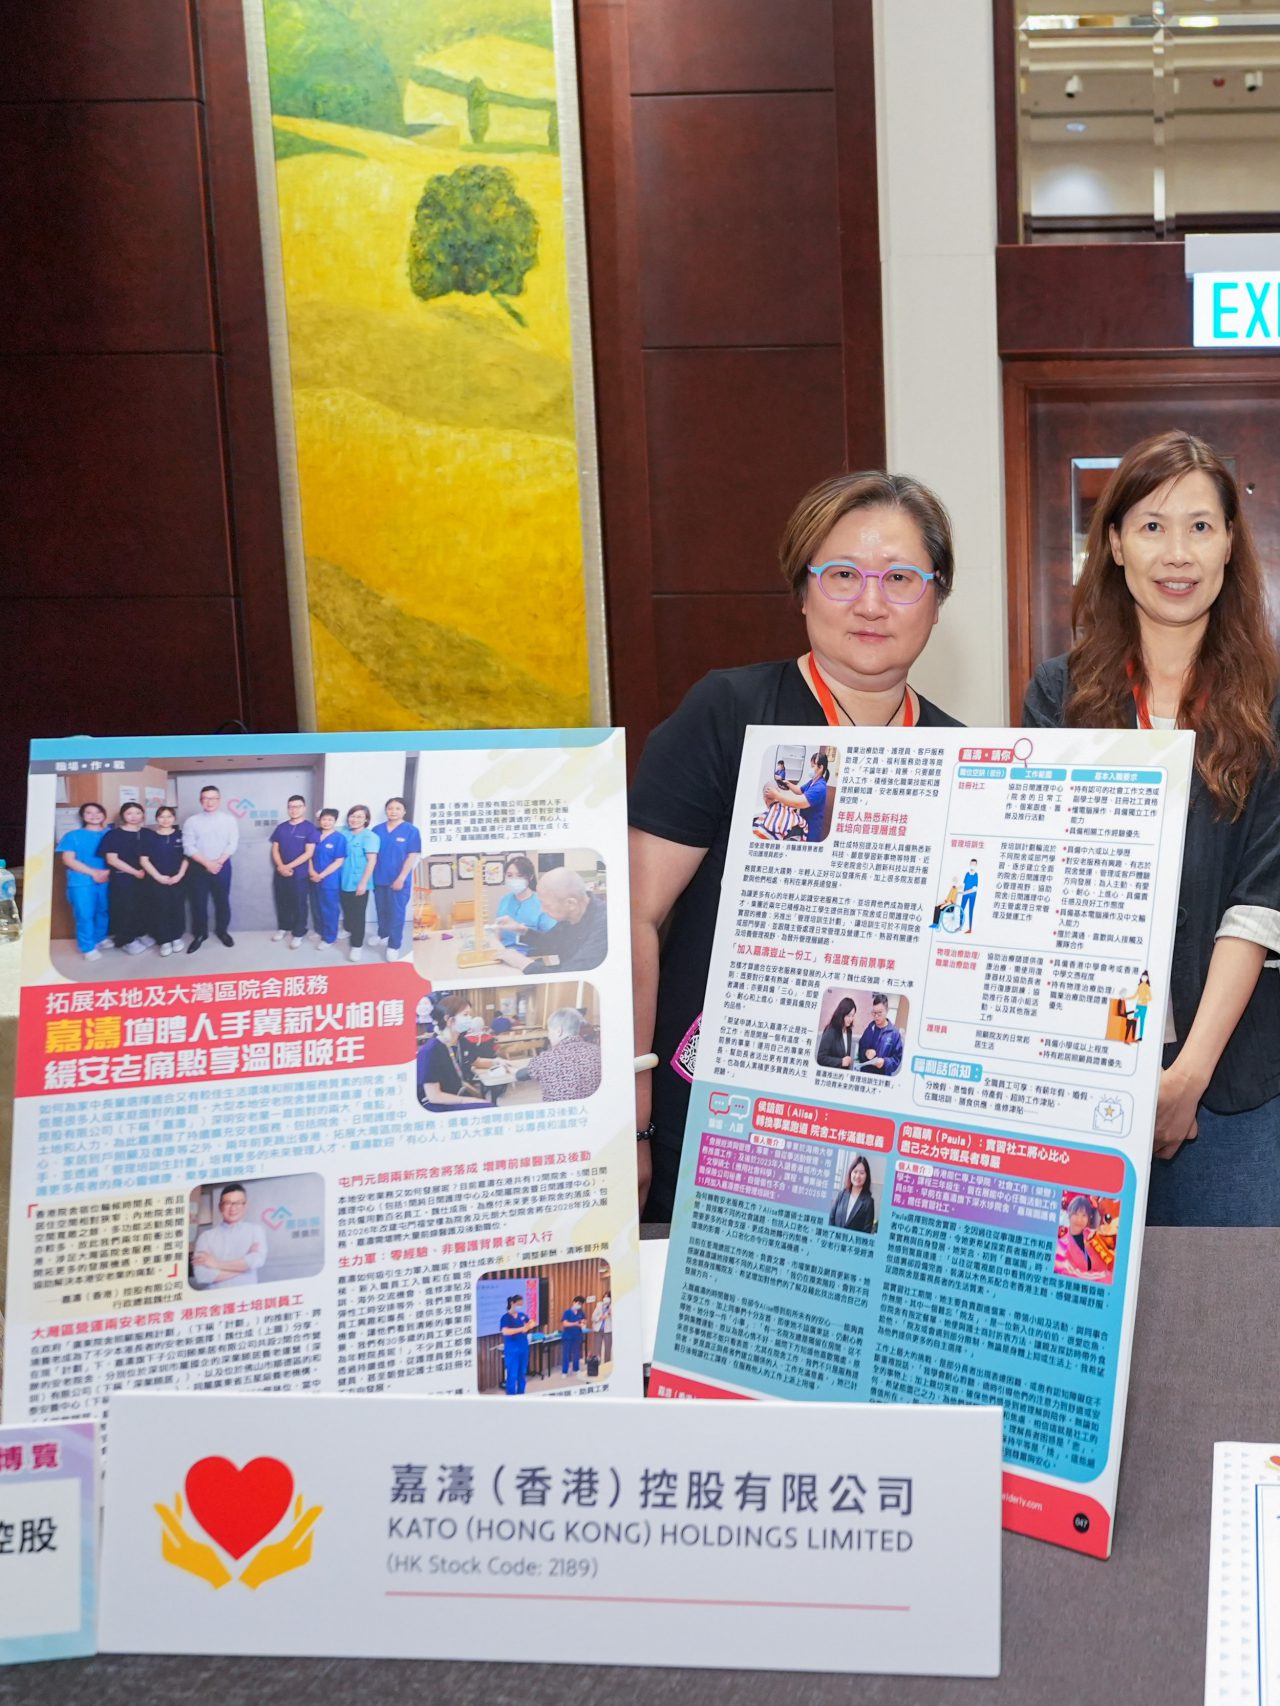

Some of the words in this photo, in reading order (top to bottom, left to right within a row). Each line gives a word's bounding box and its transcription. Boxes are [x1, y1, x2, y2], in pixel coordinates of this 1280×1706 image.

[46, 977, 329, 1014] 拓展本地及大灣區院舍服務
[45, 999, 405, 1053] 嘉濤增聘人手冀薪火相傳
[44, 1036, 366, 1090] 緩安老痛點享溫暖晚年
[391, 1462, 915, 1516] 嘉濤（香港）控股有限公司
[387, 1516, 458, 1540] KATO
[465, 1516, 556, 1544] (HONG
[565, 1518, 652, 1547] KONG)
[660, 1523, 798, 1549] HOLDINGS
[807, 1526, 914, 1553] LIMITED
[386, 1553, 422, 1576] (HK
[429, 1555, 481, 1576] Stock
[487, 1556, 542, 1578] Code:
[549, 1556, 599, 1580] 2189)
